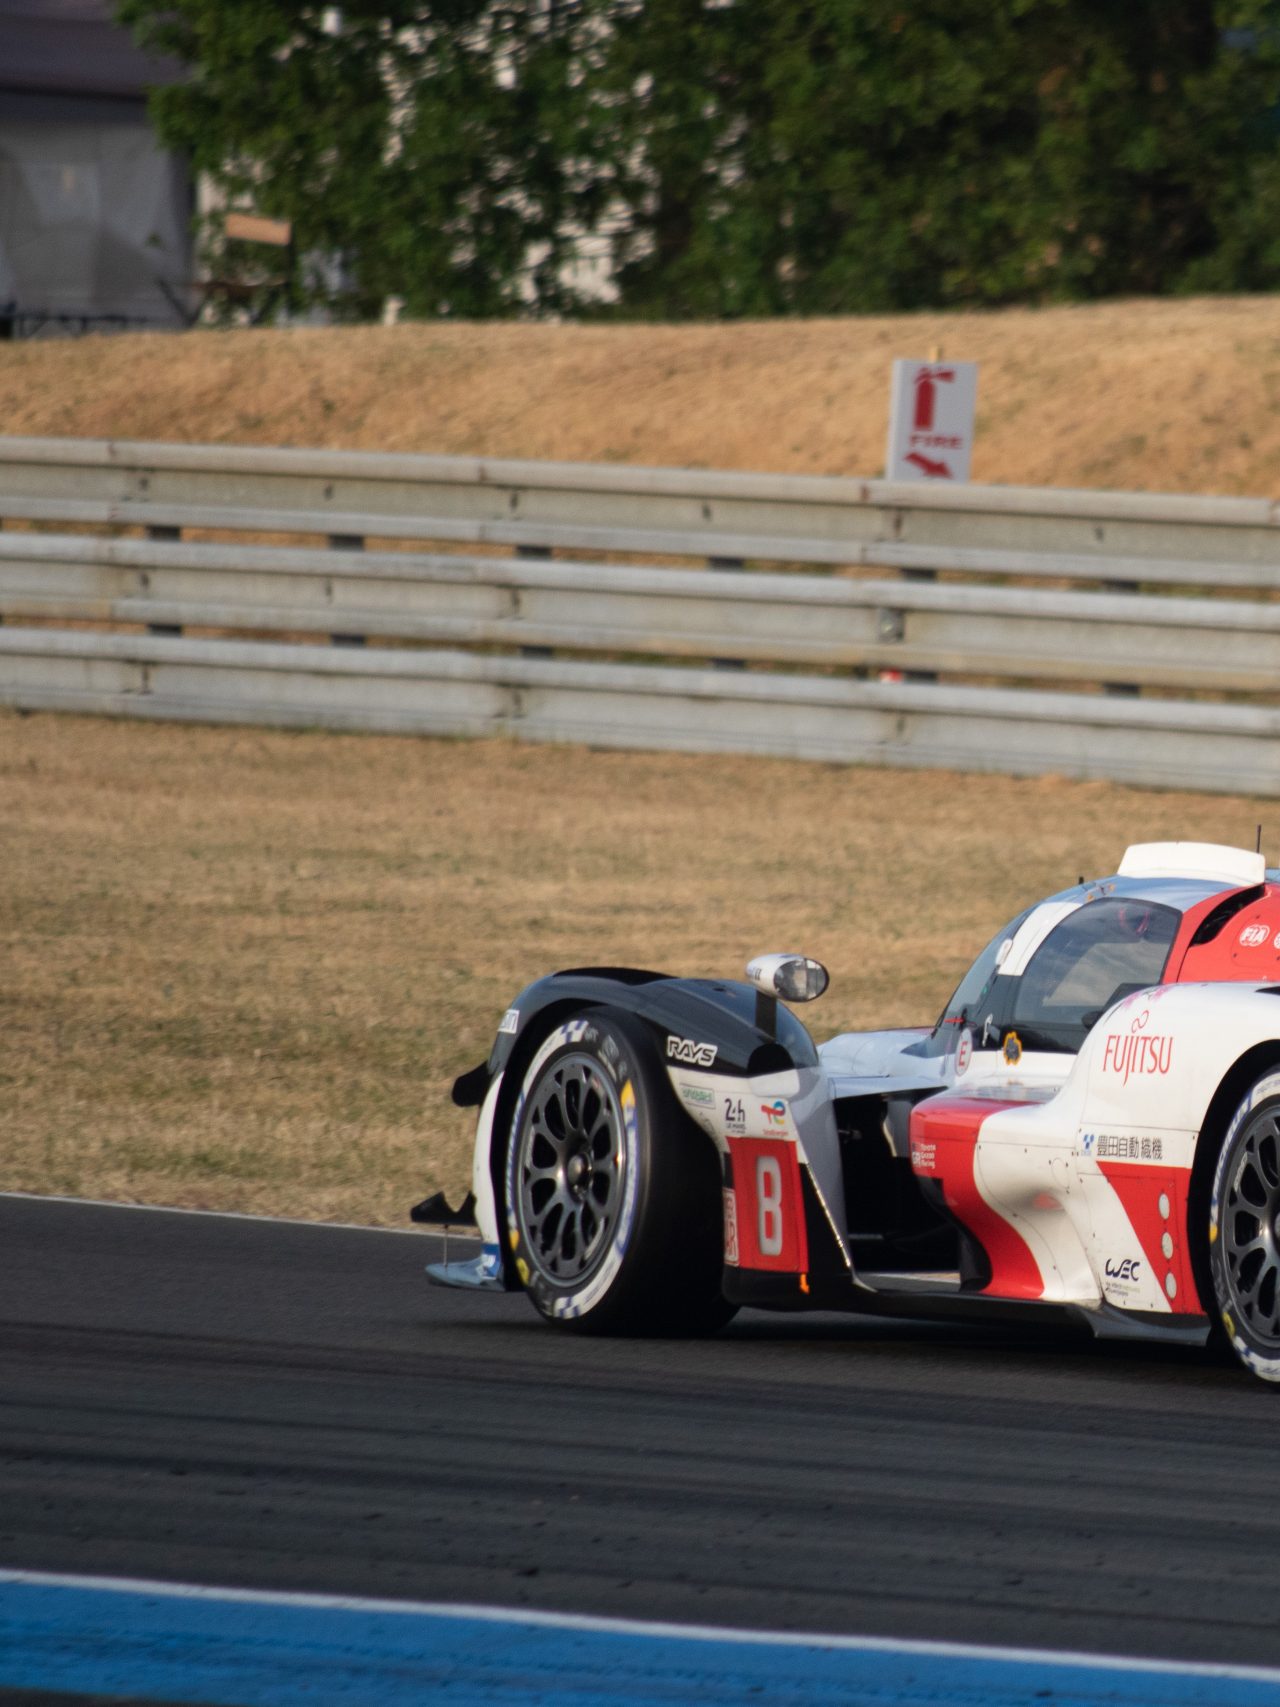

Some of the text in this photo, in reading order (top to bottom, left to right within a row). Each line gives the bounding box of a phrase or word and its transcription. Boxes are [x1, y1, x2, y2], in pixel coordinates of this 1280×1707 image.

[668, 1037, 716, 1065] RAYS
[1103, 1035, 1173, 1087] FUJITSU
[755, 1156, 783, 1256] 8
